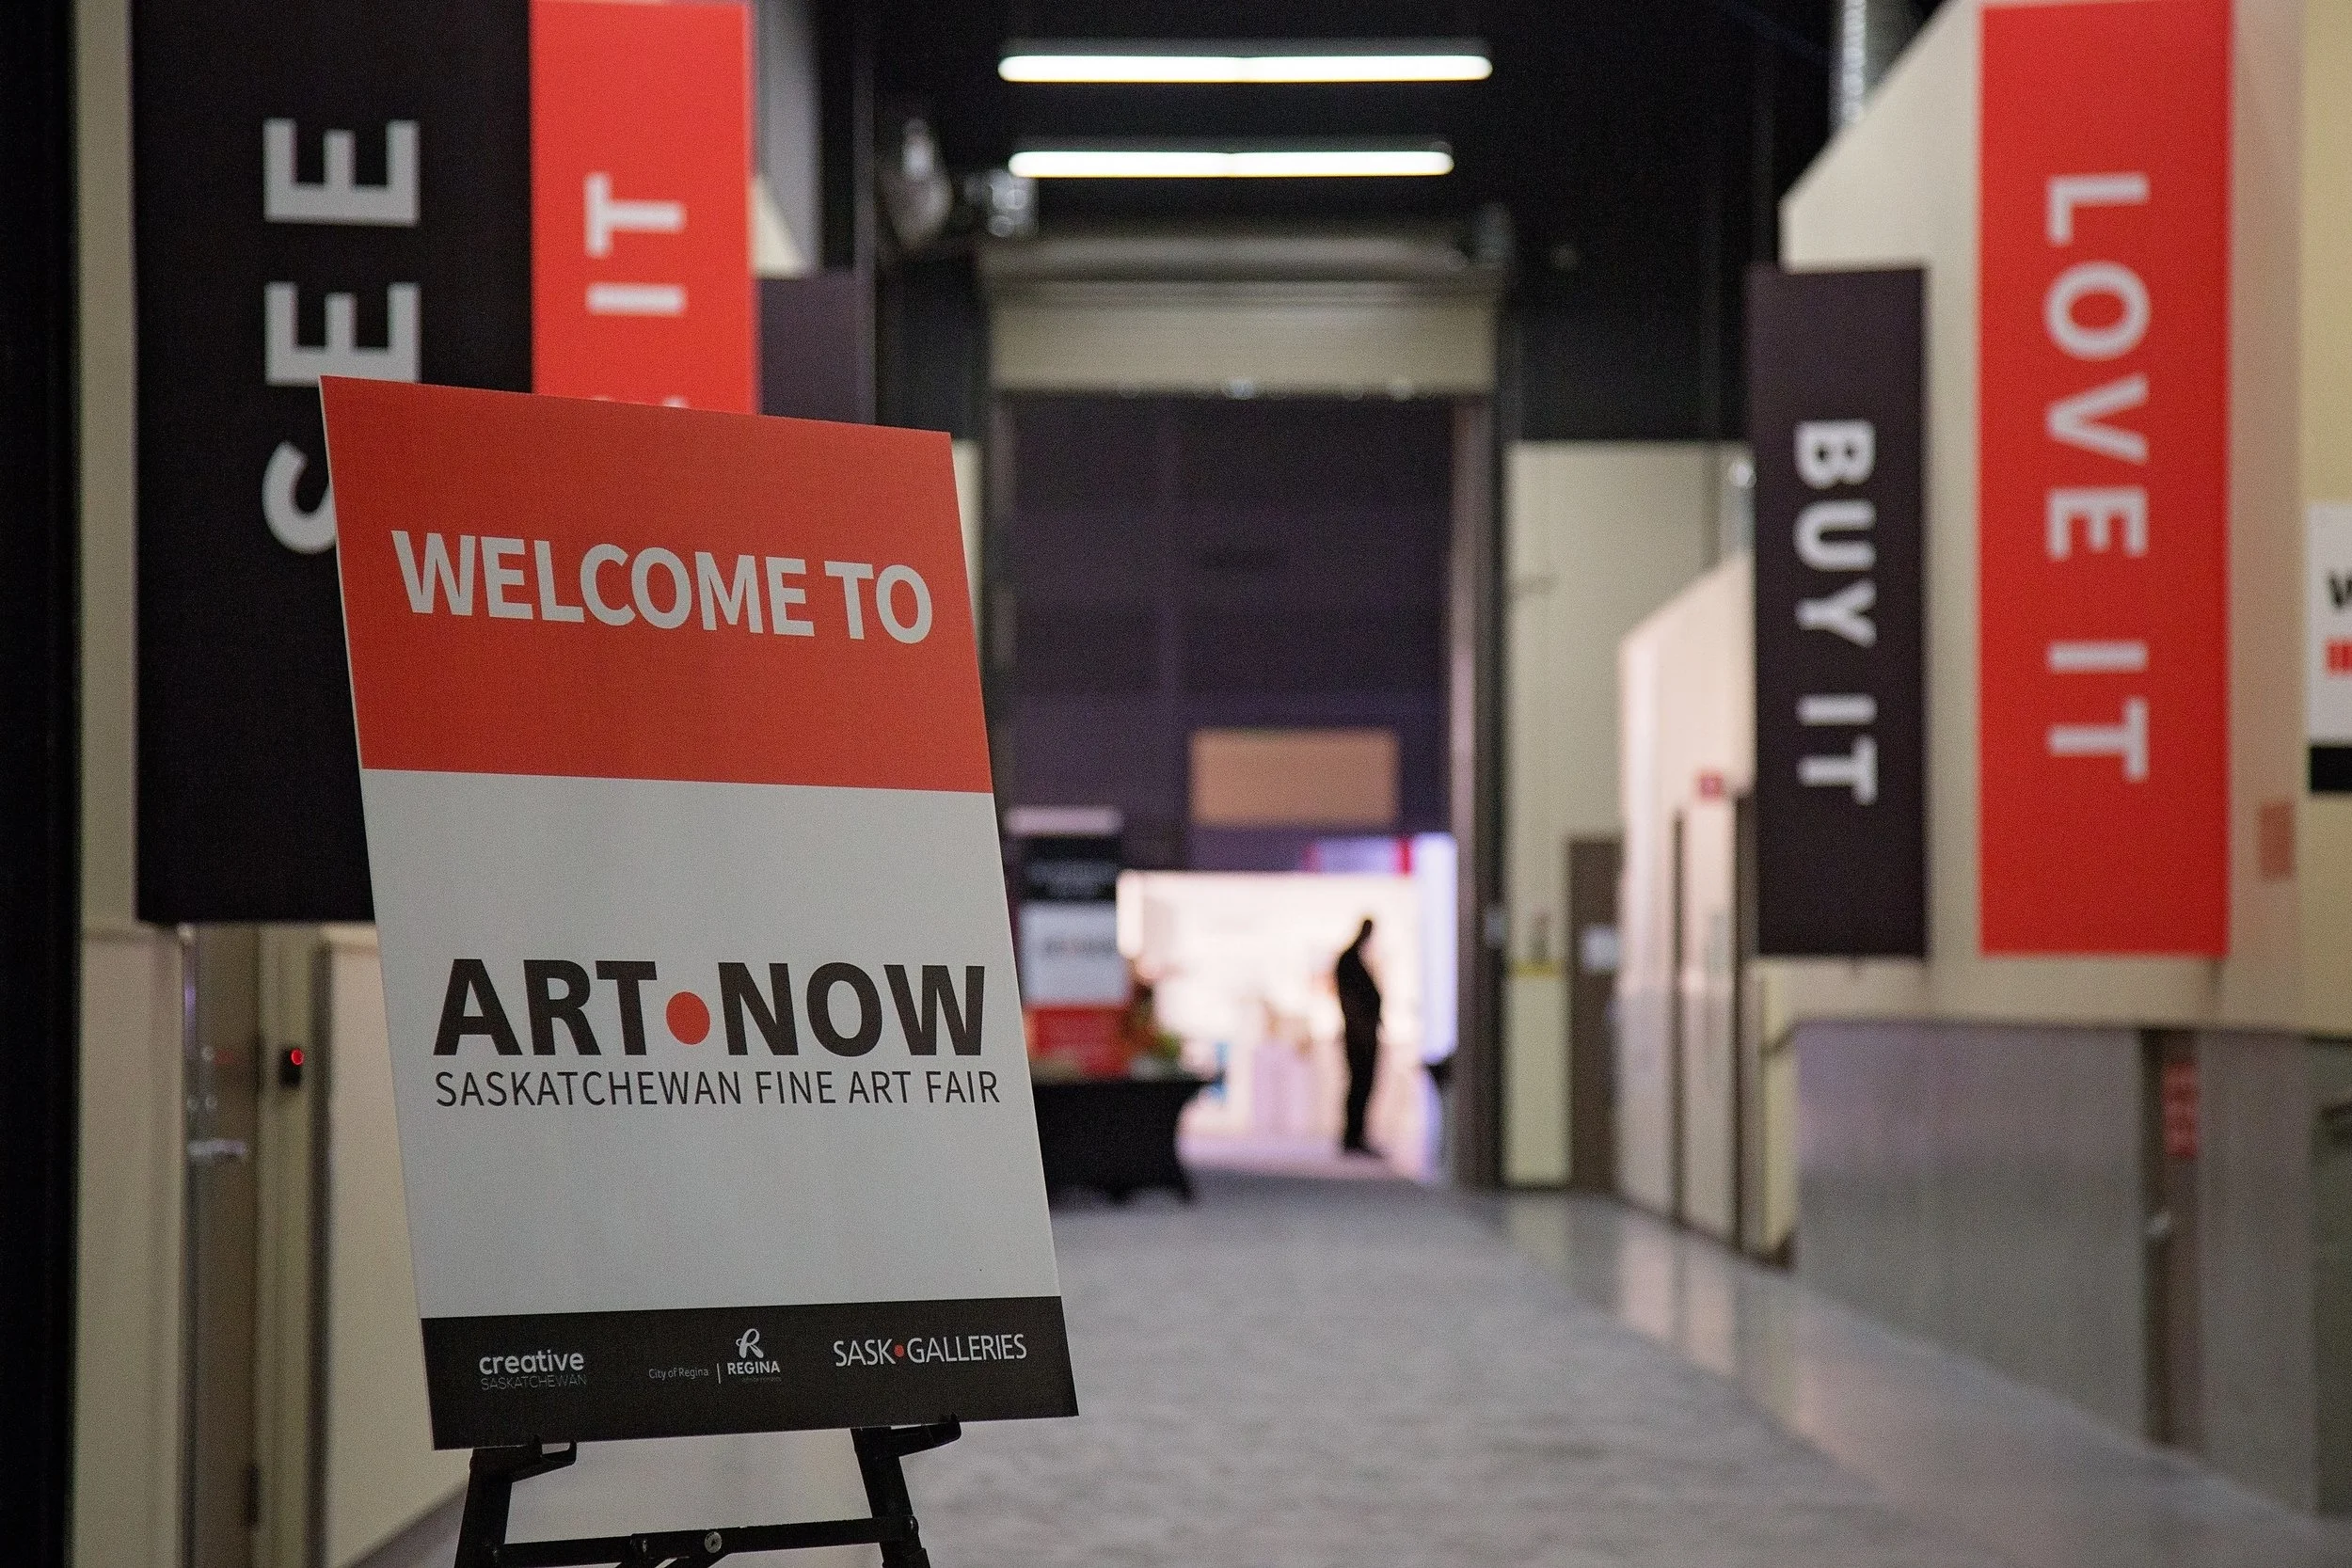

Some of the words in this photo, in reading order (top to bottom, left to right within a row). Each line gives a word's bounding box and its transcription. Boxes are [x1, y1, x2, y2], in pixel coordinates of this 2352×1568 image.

[584, 173, 685, 316] IT
[2045, 171, 2152, 561] LOVE
[1794, 420, 1877, 649] BUY
[390, 530, 816, 638] WELCOME
[824, 560, 933, 644] TO
[1796, 694, 1878, 806] IT
[2047, 641, 2150, 782] IT
[433, 958, 658, 1056] ART
[718, 961, 985, 1057] NOW
[436, 1070, 741, 1106] SASKATCHEWAN
[756, 1070, 836, 1104] FINE
[848, 1070, 912, 1104] ART
[927, 1070, 1000, 1104] FAIR
[479, 1349, 584, 1375] creative
[481, 1374, 587, 1390] SASKATCHEWAN
[648, 1369, 666, 1381] City
[668, 1367, 677, 1377] of
[678, 1367, 709, 1380] Regina
[727, 1360, 781, 1375] REGINA
[834, 1338, 896, 1367] SASK
[907, 1334, 1027, 1364] GALLERIES
